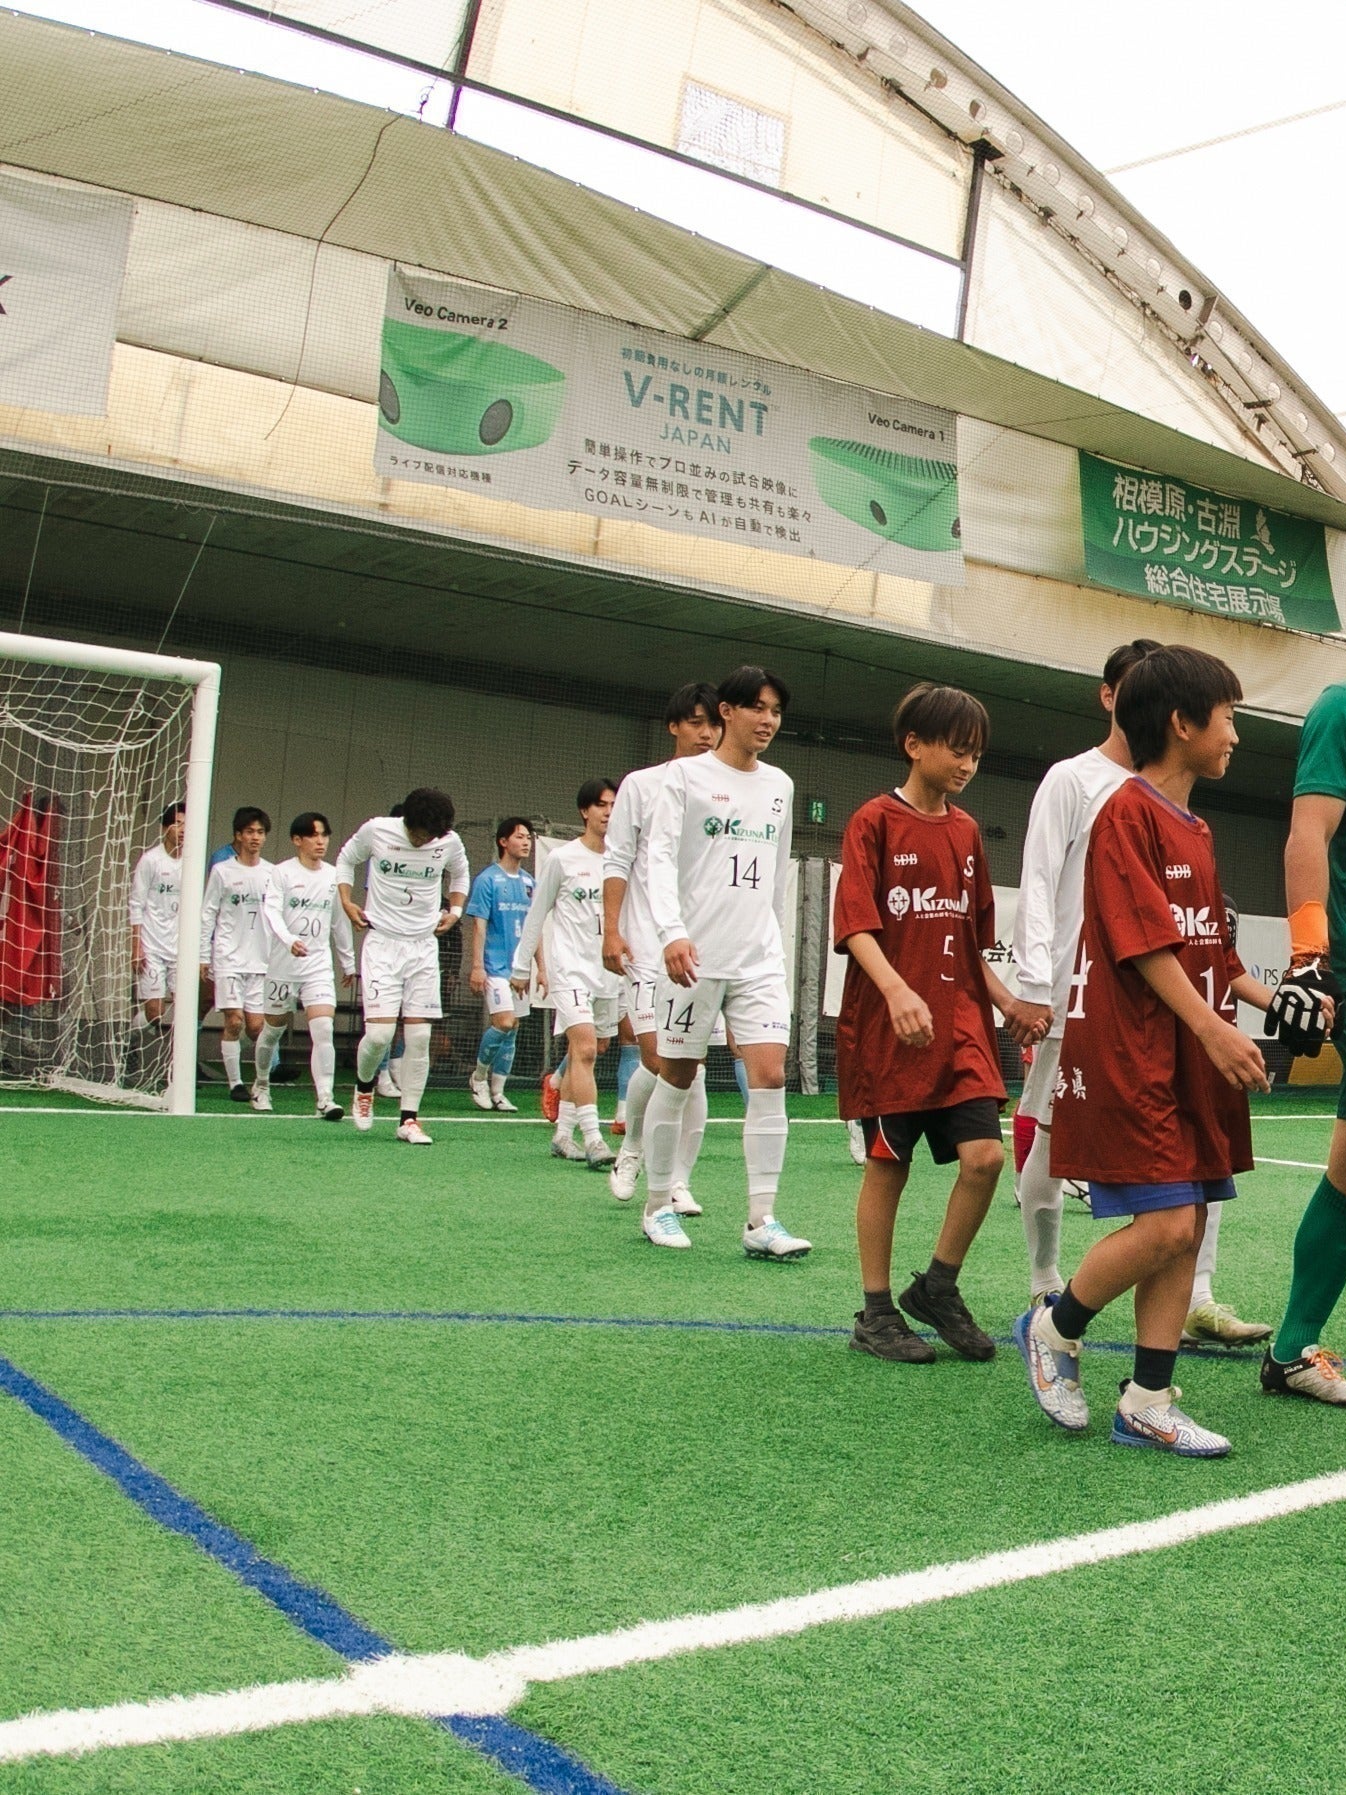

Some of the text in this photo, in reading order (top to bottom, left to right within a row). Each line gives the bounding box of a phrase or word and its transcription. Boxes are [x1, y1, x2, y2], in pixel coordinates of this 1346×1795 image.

[404, 297, 508, 330] Veo Camera 2
[623, 370, 769, 437] V-RENT
[659, 422, 731, 455] JAPAN
[868, 412, 944, 442] Veo Camera 1
[585, 438, 798, 498] 簡単操作でプロ並みの試合映像に
[567, 459, 812, 523] データ容量無制限で管理も共有も楽々
[1112, 515, 1297, 590] ハウジングステージ
[1143, 563, 1287, 624] 総合住宅展示場
[728, 853, 762, 890] 14
[893, 853, 918, 866] SDB
[1164, 864, 1192, 880] SDB
[248, 911, 257, 930] 7
[298, 916, 322, 938] 20
[267, 981, 289, 1002] 20
[367, 980, 379, 1001] 5
[663, 998, 696, 1034] 14
